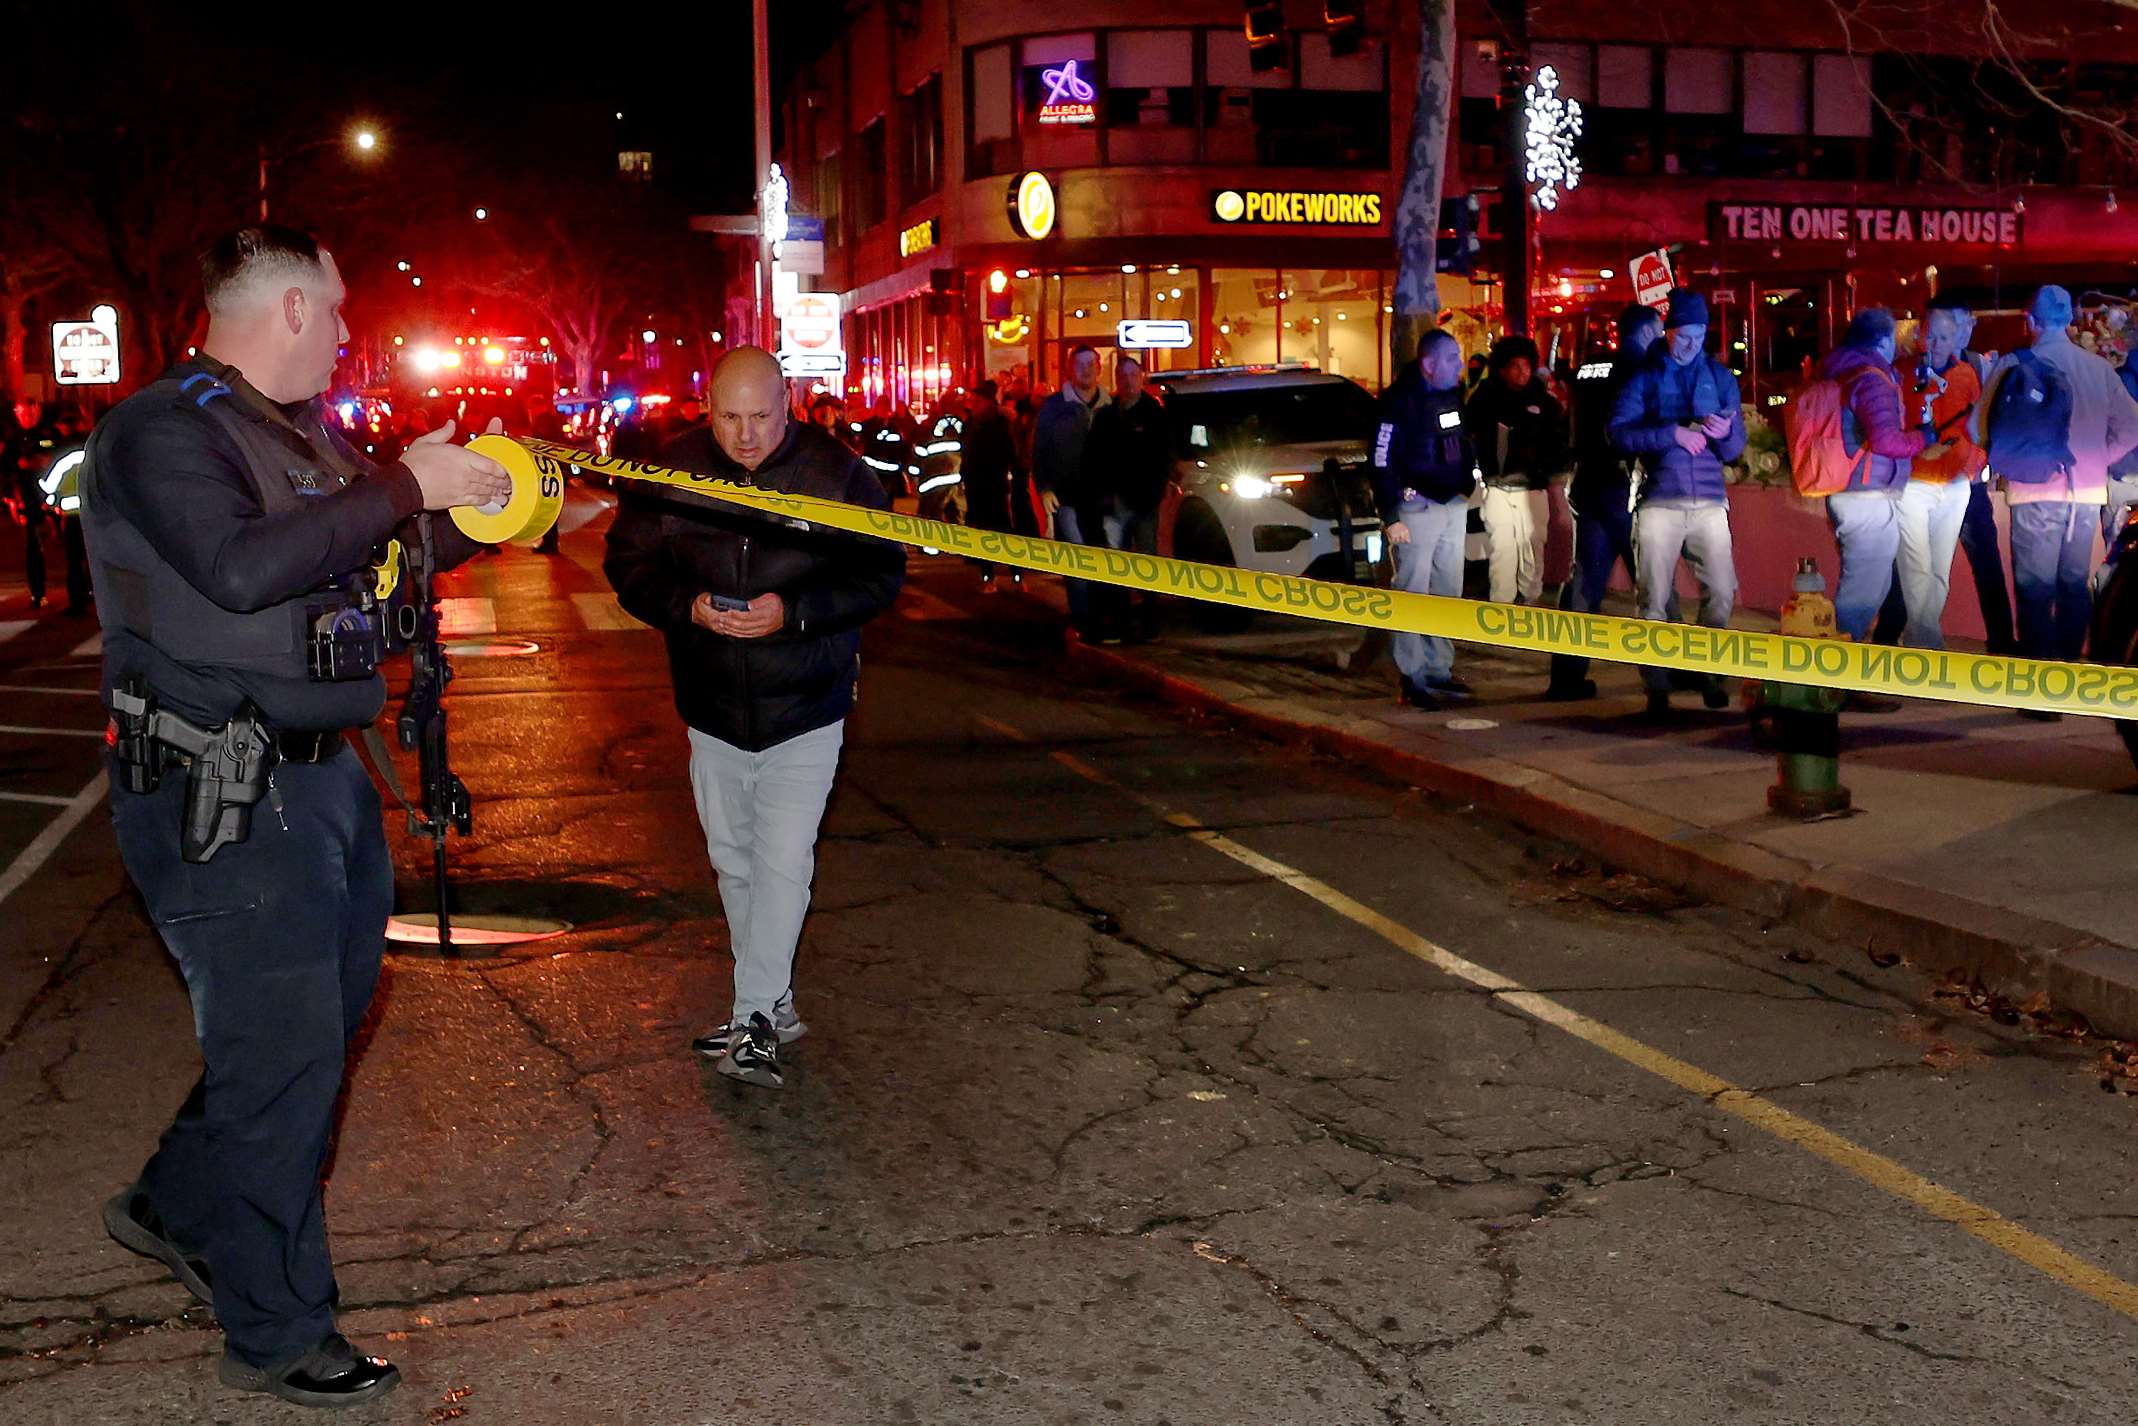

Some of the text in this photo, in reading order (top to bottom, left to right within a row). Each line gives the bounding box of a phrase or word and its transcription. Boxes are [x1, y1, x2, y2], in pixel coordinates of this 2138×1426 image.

[1040, 104, 1094, 116] ALLEGRA
[1246, 192, 1381, 224] POKEWORKS
[1722, 206, 2017, 243] TEN ONE TEA HOUSE
[1639, 267, 1665, 286] DO NOT
[1374, 422, 1394, 468] POLICE
